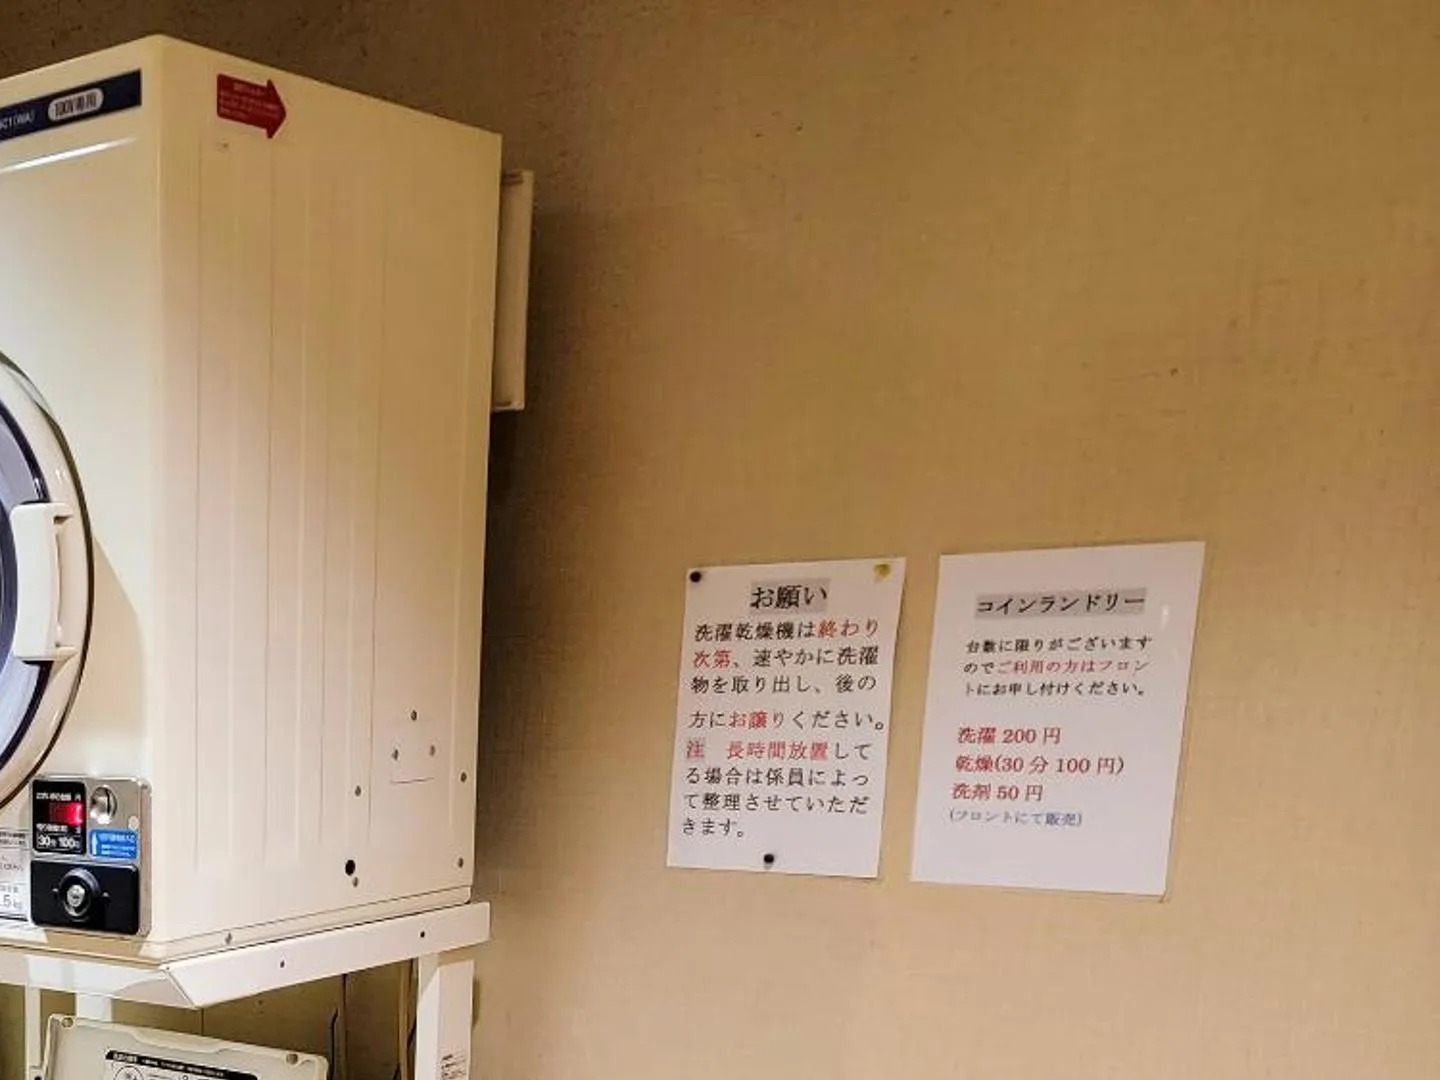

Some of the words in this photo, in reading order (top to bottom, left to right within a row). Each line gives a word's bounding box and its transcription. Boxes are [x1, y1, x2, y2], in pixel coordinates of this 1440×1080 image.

[750, 584, 828, 609] お願い
[977, 593, 1145, 615] コインランドリー
[694, 617, 879, 642] 洗濯乾燥機は終わり
[965, 635, 1152, 654] 台数に限りがございます
[692, 646, 879, 669] 次第、速やかに洗濯
[963, 659, 1149, 675] のでご利用の方はフロン
[690, 674, 876, 695] 物を取り出し、後の
[965, 681, 1145, 696] トにお申し付けください。
[688, 710, 885, 731] 方にお譲りください。
[957, 726, 996, 745] 洗濯
[1001, 728, 1036, 744] 200
[1042, 727, 1061, 745] 円
[726, 740, 873, 761] 長時間放置して
[1029, 756, 1049, 775] 分
[1056, 757, 1091, 774] 100
[1097, 756, 1125, 775] 円)
[686, 766, 869, 787] る場合は係員によっ
[952, 782, 992, 800] 洗剤
[996, 784, 1020, 800] 50
[1025, 784, 1044, 802] 円
[683, 793, 871, 814] て整理させていただ
[682, 817, 744, 838] きます。
